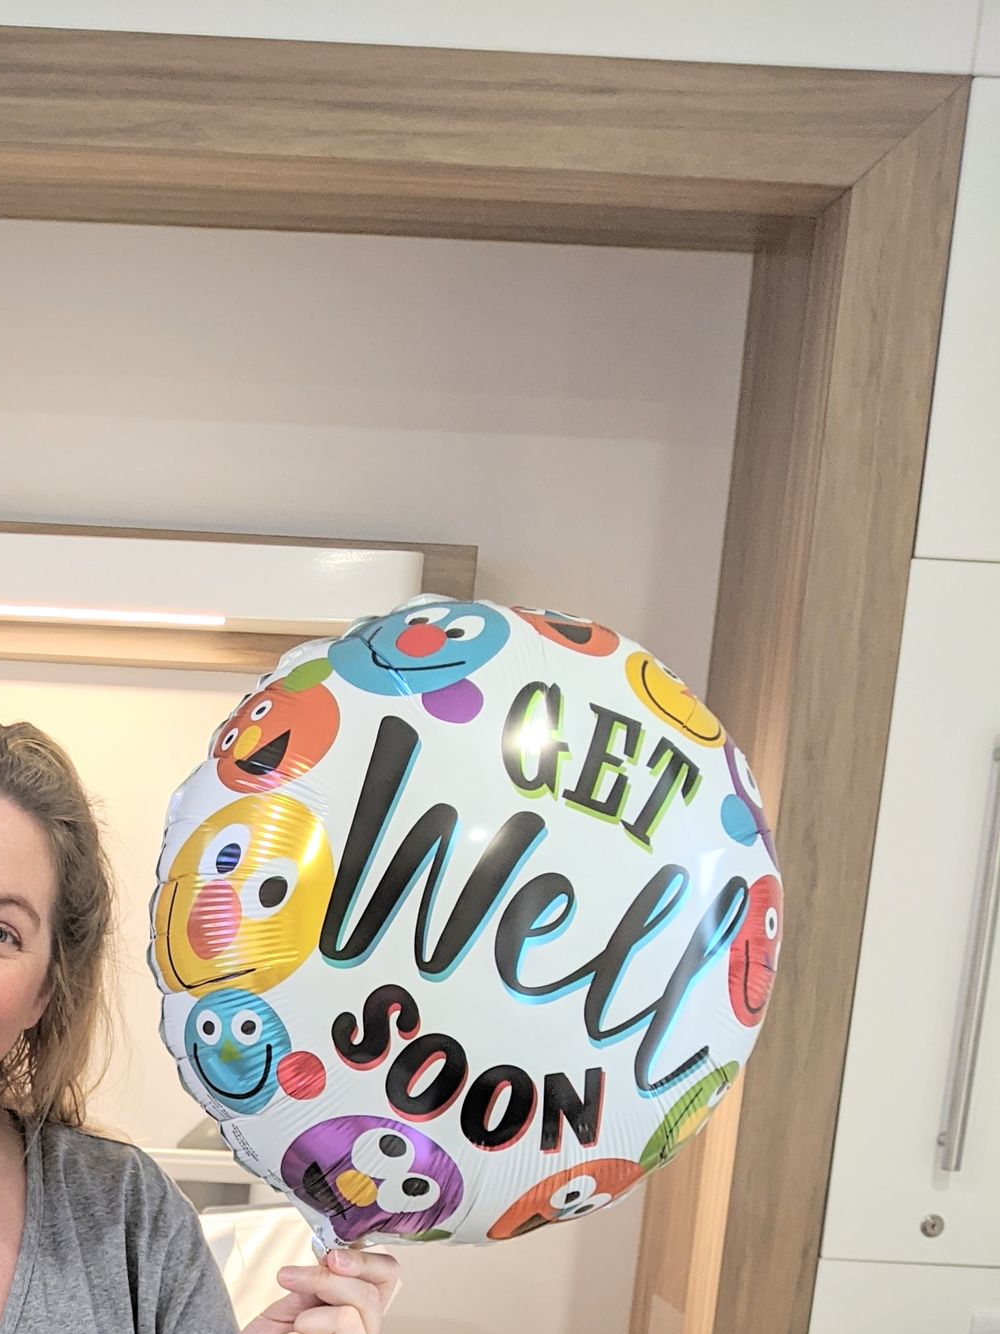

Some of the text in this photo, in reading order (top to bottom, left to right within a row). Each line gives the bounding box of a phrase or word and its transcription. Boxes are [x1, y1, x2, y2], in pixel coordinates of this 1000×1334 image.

[502, 681, 704, 854] GET
[319, 715, 750, 1100] Well
[331, 983, 605, 1155] SOON
